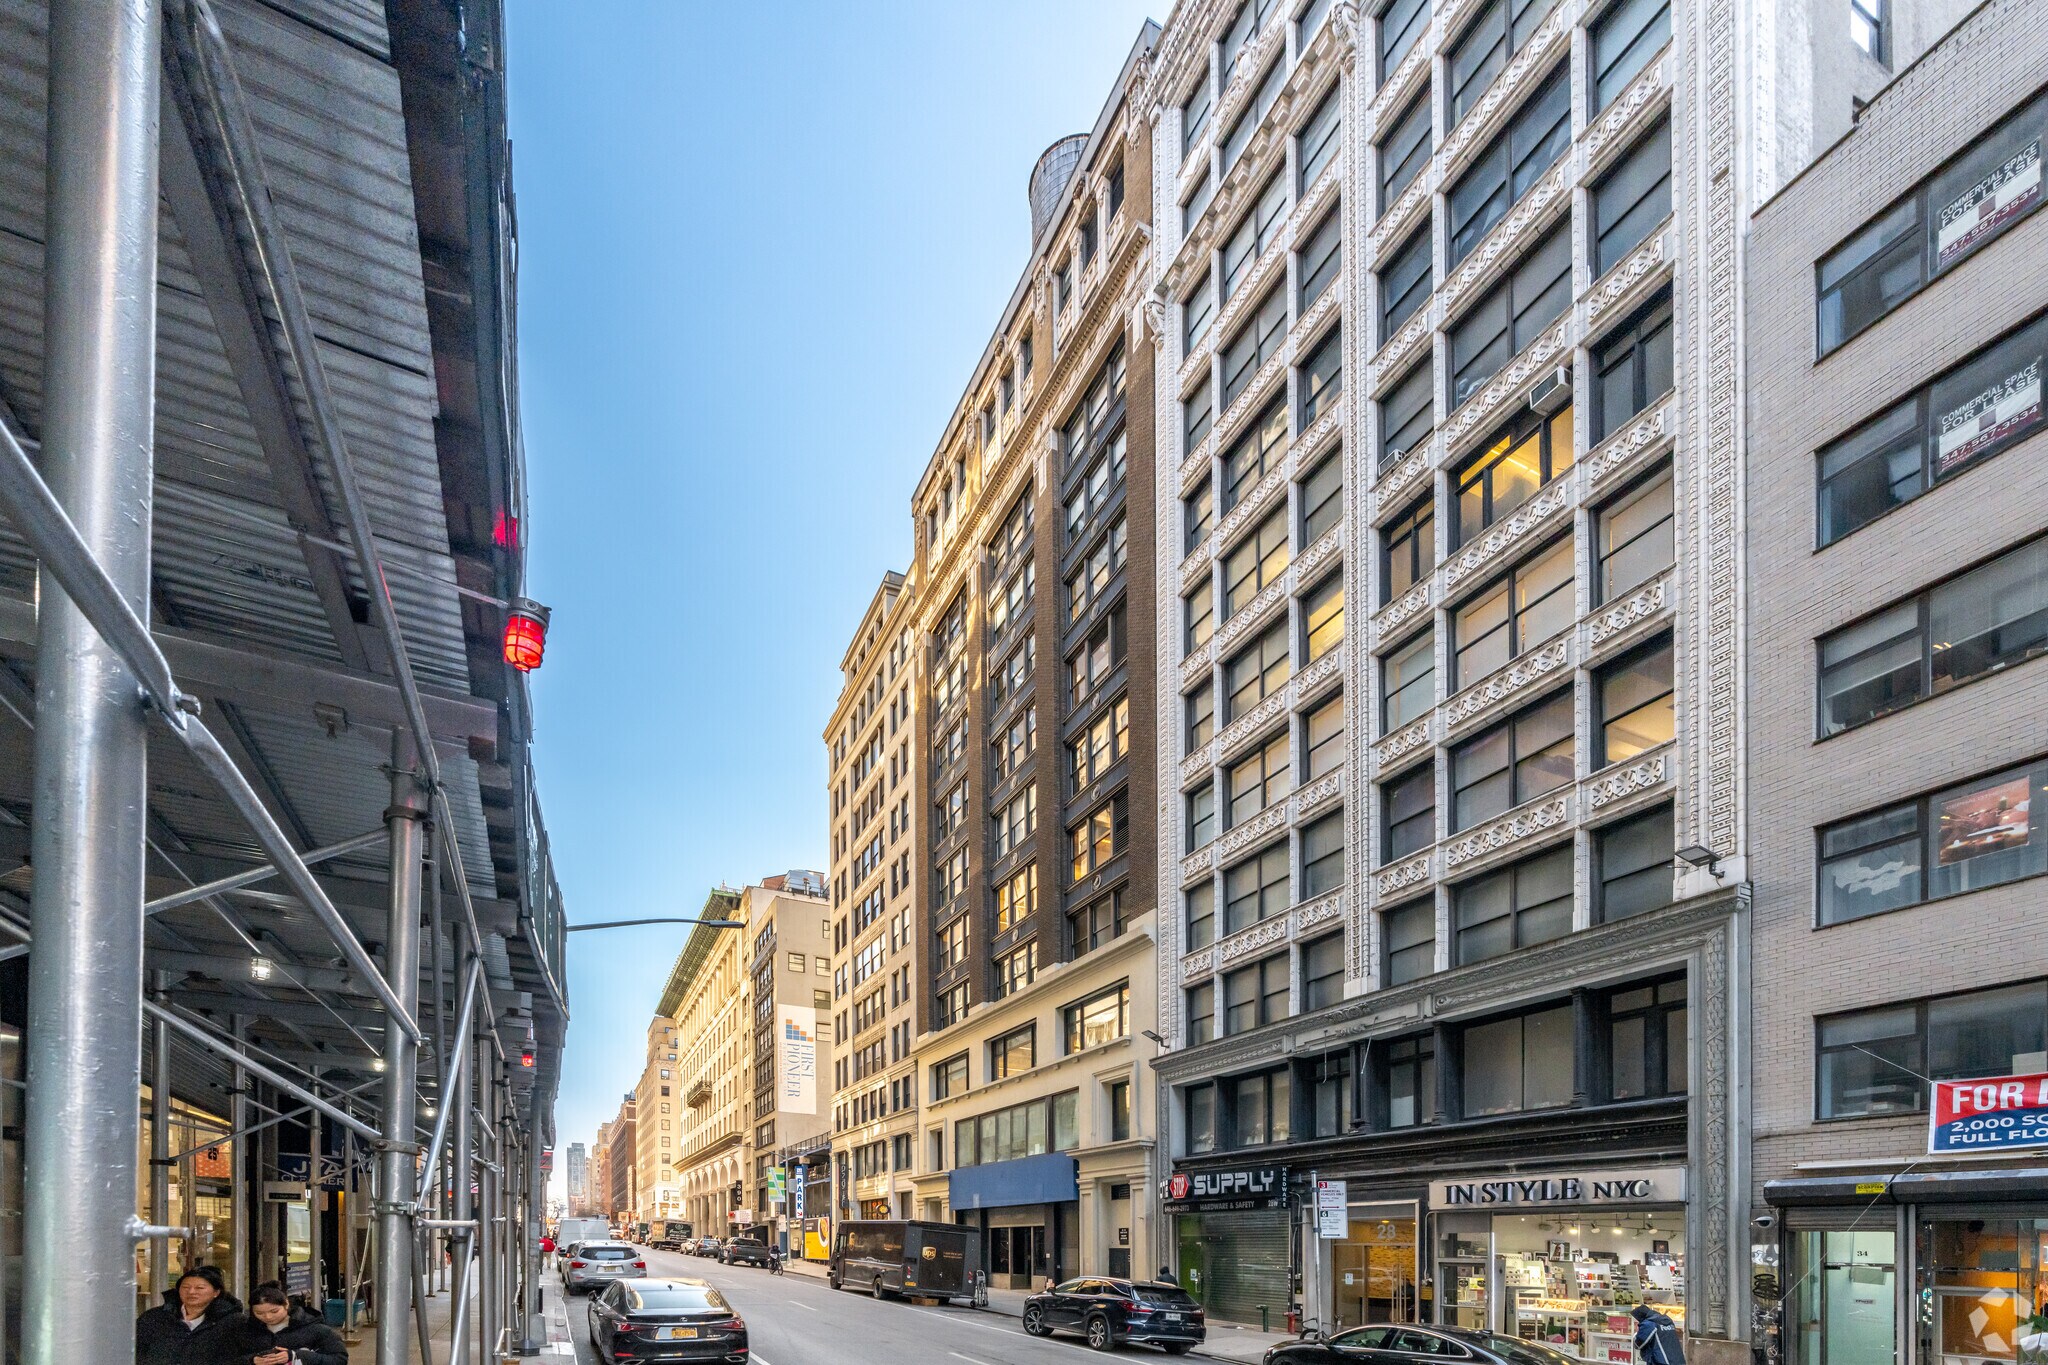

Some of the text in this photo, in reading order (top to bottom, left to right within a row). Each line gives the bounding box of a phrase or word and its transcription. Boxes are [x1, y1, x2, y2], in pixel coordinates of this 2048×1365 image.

[1941, 142, 2037, 219] COMMERCIAL SPACE
[1942, 153, 2037, 227] FOR LEASE
[1942, 186, 2038, 258] 347-567-3534
[1942, 362, 2037, 425] COMMERCIAL SPACE
[1942, 372, 2037, 433] FOR LEASE
[1942, 405, 2038, 464] 347-567-3534
[787, 1042, 800, 1097] PIONEER
[801, 1044, 814, 1080] FIRST
[1952, 1082, 2025, 1114] FOR
[1949, 1132, 2002, 1144] FULL
[1951, 1117, 2015, 1132] 2,000
[1173, 1177, 1185, 1196] STOP
[1193, 1170, 1274, 1195] SUPPLY
[1444, 1178, 1650, 1204] IN STYLE NYC
[1200, 1202, 1229, 1211] HARDWARE
[1230, 1202, 1235, 1210] &
[1235, 1201, 1255, 1210] SAFETY
[1377, 1225, 1396, 1239] 28
